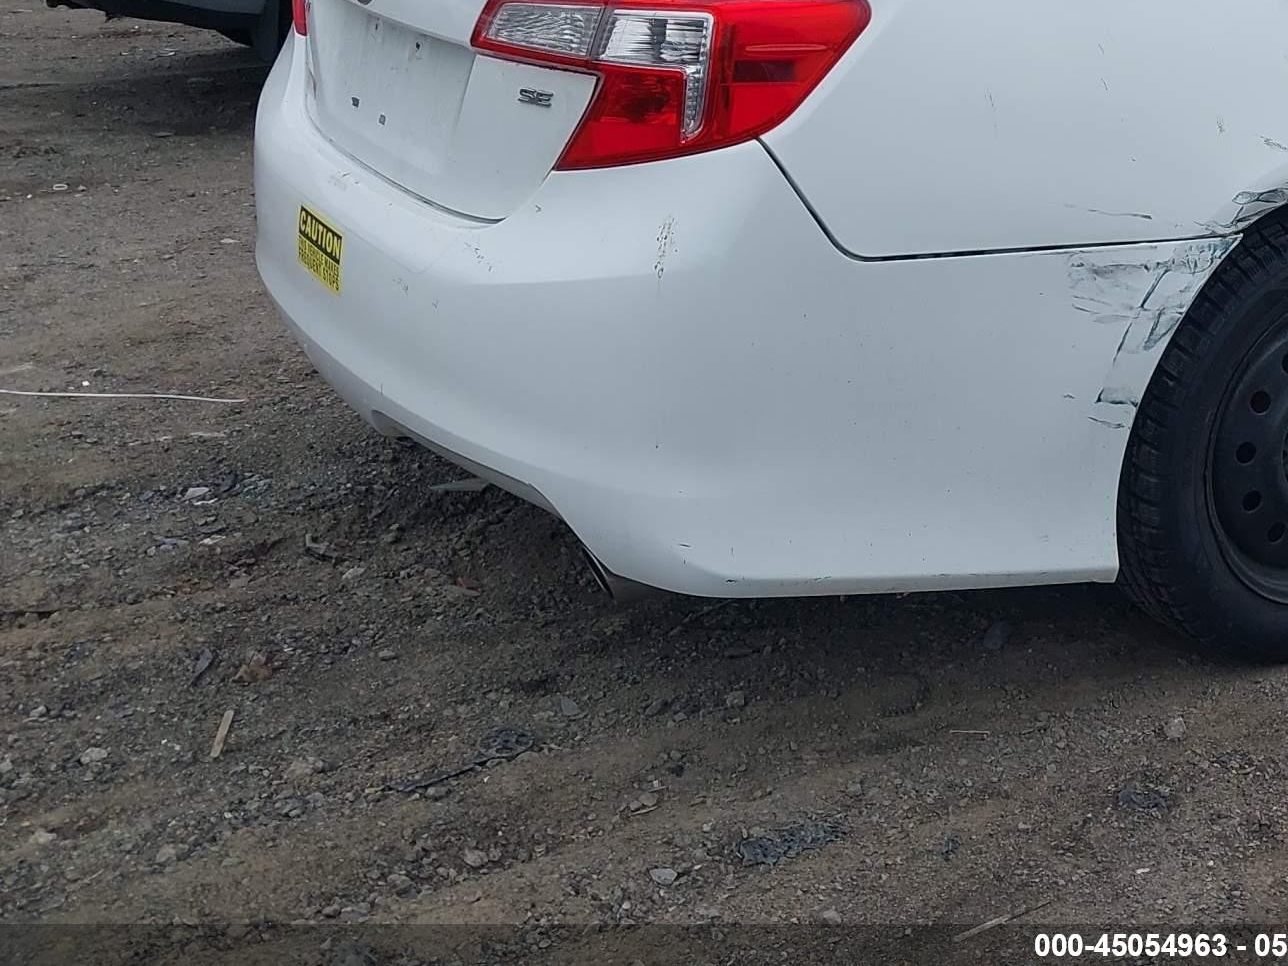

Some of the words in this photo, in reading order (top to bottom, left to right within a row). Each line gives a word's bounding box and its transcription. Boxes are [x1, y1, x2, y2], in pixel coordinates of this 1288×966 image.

[518, 88, 554, 108] SE
[300, 210, 341, 260] CAUTION
[322, 266, 340, 291] STOPS
